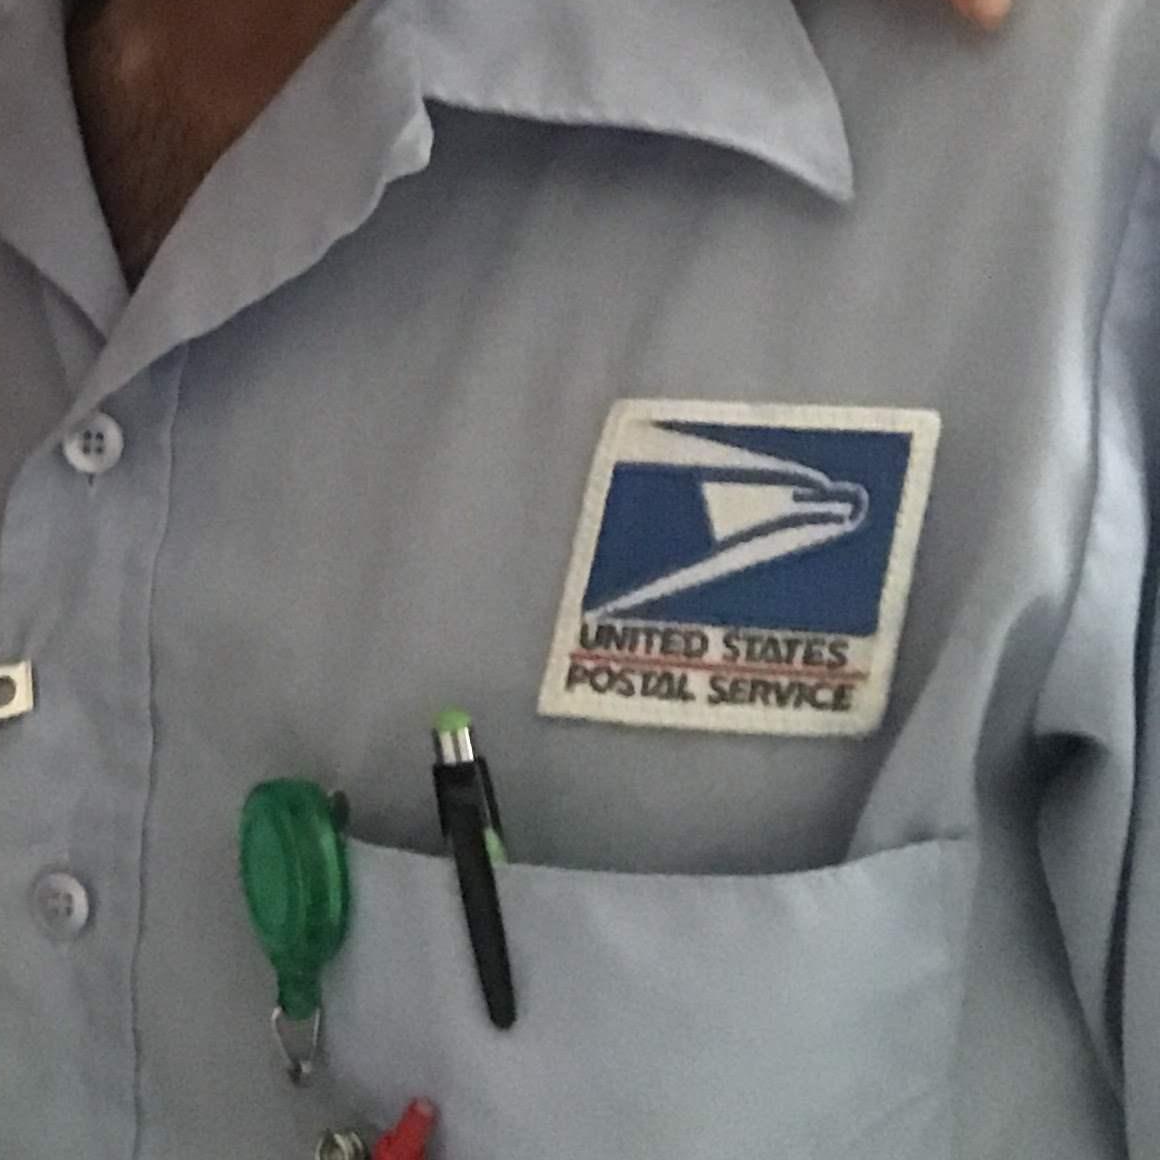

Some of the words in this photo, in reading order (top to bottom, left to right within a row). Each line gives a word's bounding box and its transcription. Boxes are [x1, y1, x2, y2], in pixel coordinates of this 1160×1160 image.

[580, 623, 709, 658] UNITED
[722, 628, 849, 669] STATES
[565, 663, 696, 702] POSTAL
[708, 675, 855, 712] SERVICE
